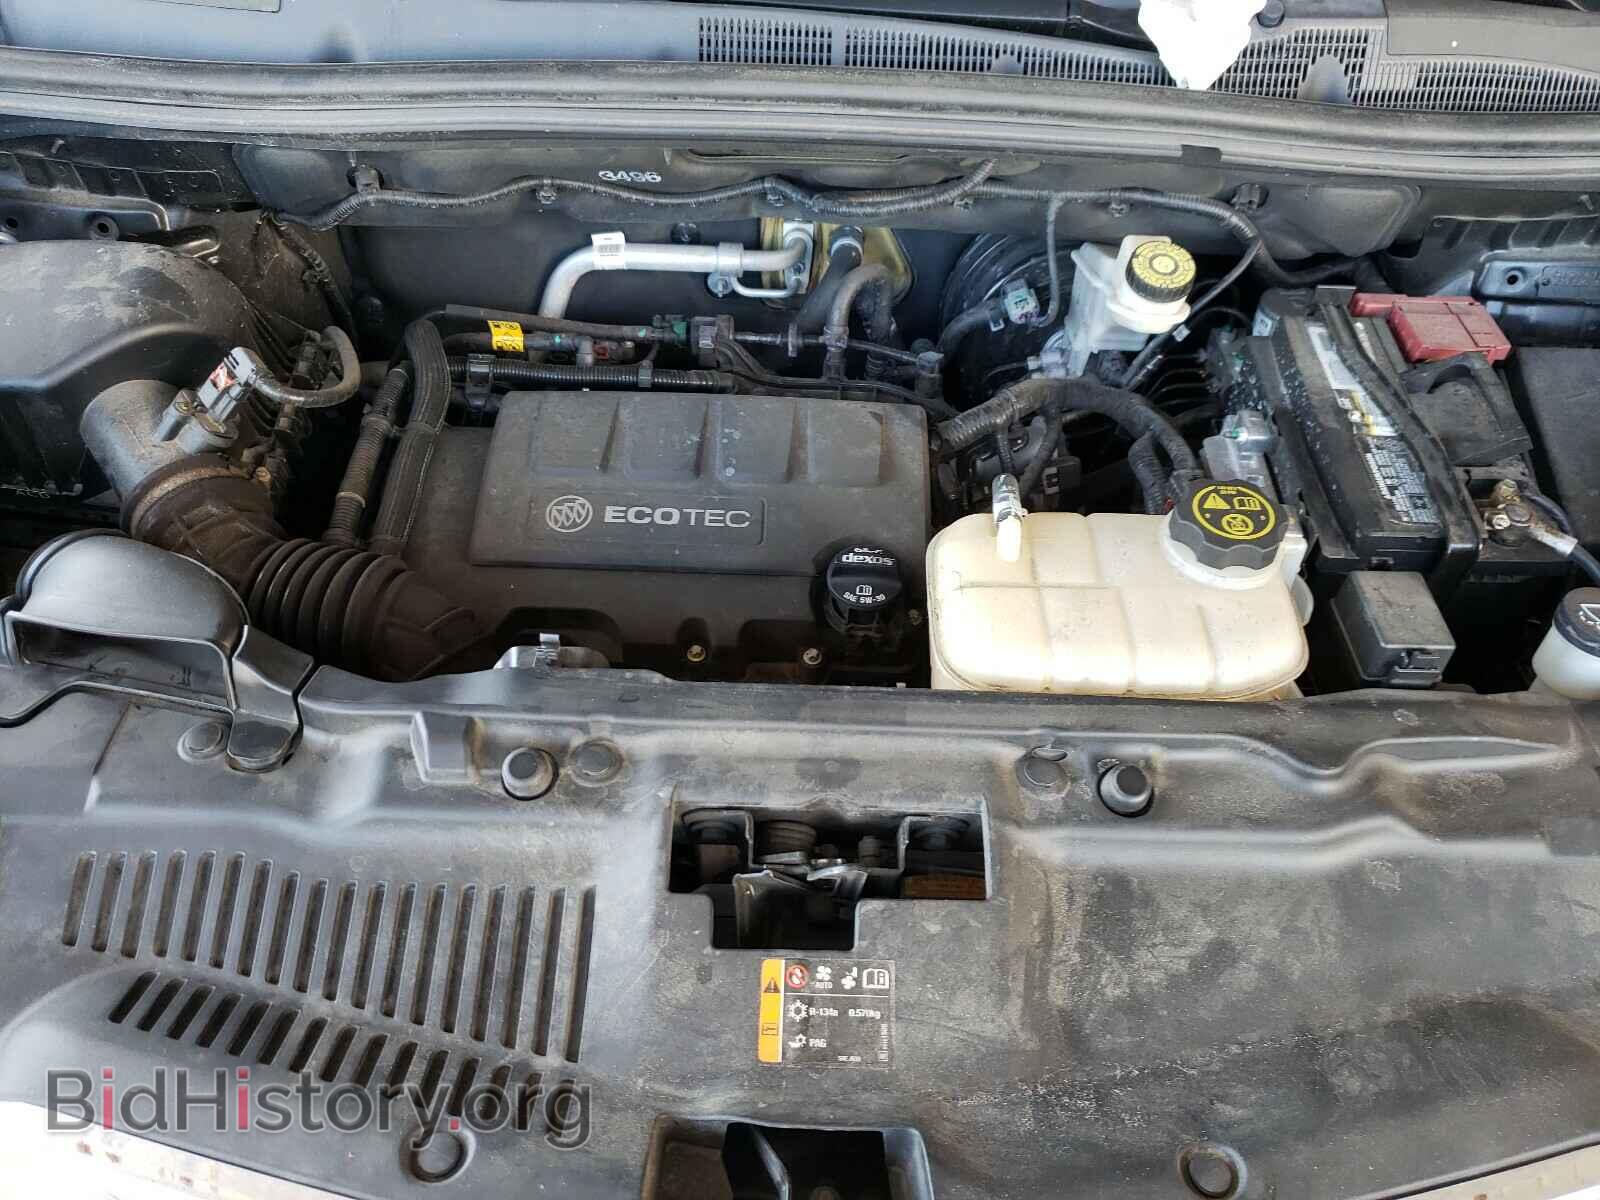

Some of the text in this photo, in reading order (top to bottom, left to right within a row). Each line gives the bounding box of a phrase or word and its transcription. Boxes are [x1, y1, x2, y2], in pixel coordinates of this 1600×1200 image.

[598, 170, 662, 183] 3496
[603, 505, 751, 528] ECOTEC
[841, 552, 896, 566] dexos
[843, 591, 887, 604] SAE 5W-30
